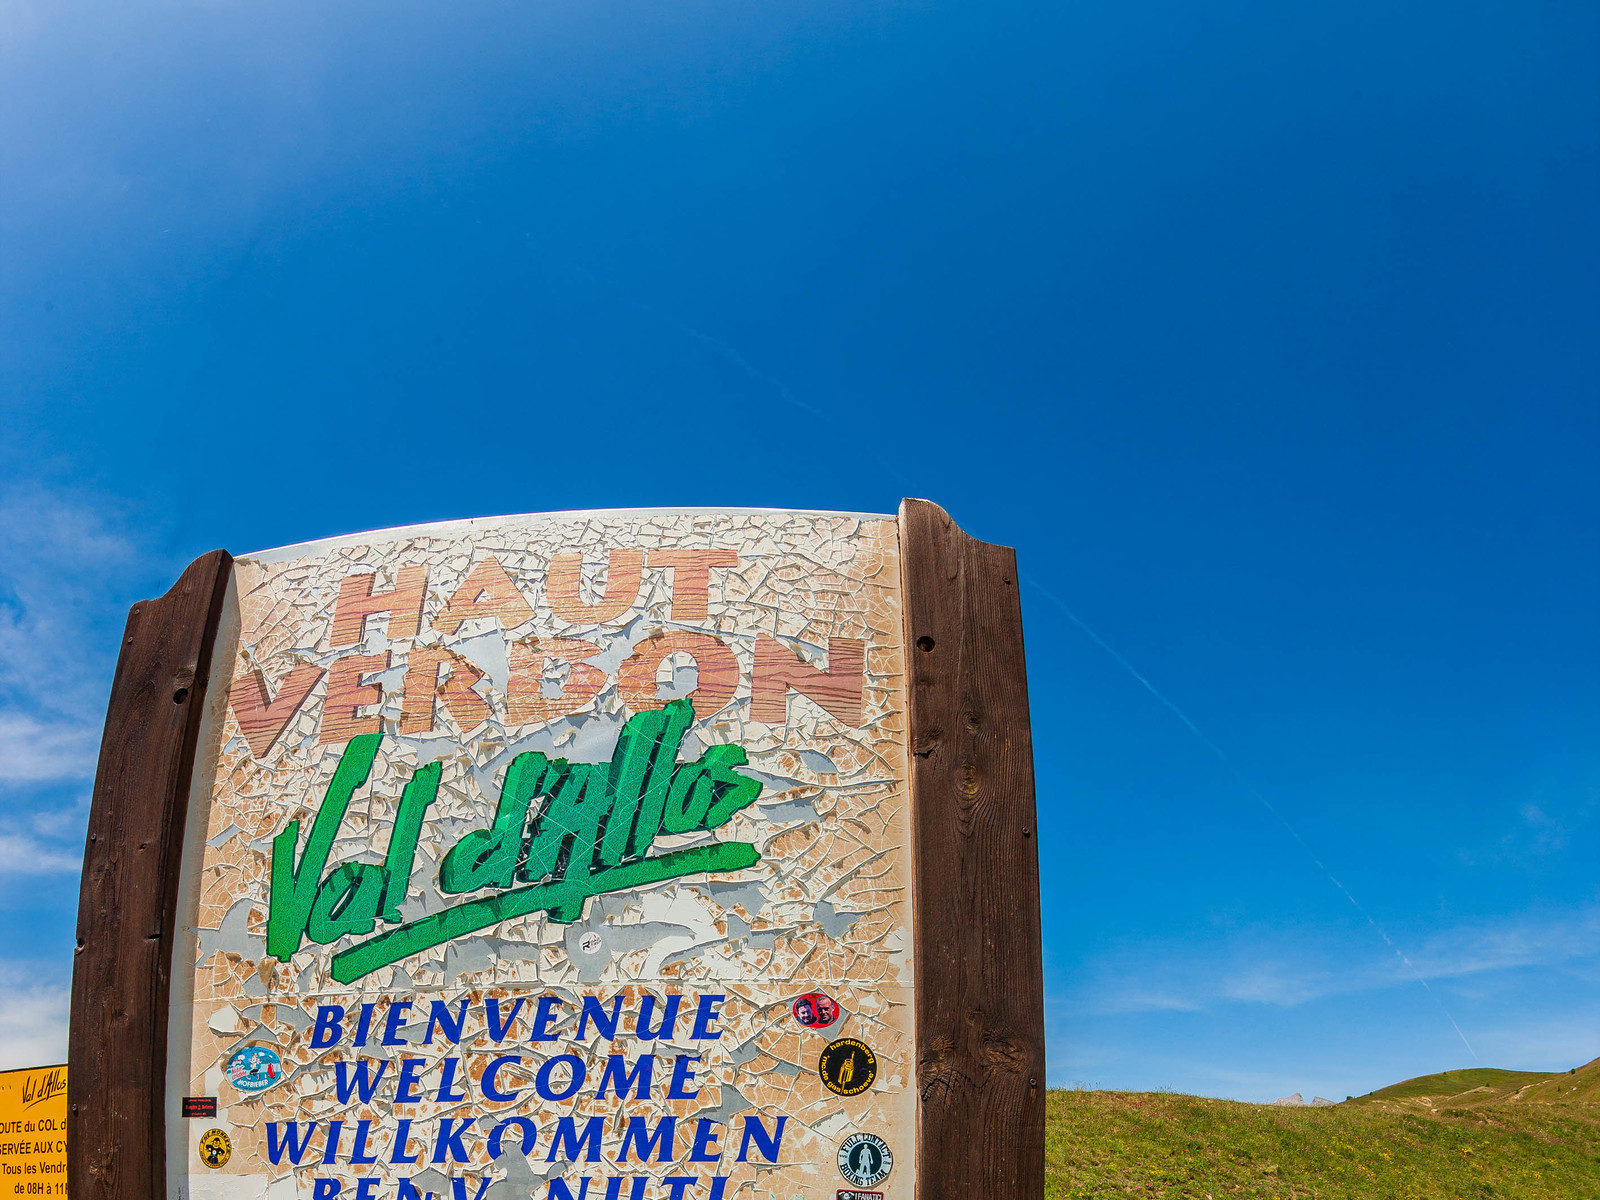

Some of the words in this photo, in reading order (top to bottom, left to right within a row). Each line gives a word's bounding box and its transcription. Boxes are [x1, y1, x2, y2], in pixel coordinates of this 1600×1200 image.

[331, 548, 739, 648] HAUT
[267, 731, 443, 963] Val
[308, 993, 726, 1049] BIENVENUE
[829, 1038, 875, 1065] hardenberg
[22, 1076, 38, 1104] Val
[333, 1053, 703, 1105] WELCOME
[0, 1121, 22, 1134] OUTE
[24, 1120, 36, 1133] du
[38, 1118, 58, 1132] COL
[0, 1139, 32, 1155] ERVÉE
[33, 1141, 53, 1154] AUX
[55, 1140, 67, 1153] CY
[265, 1114, 787, 1167] WILLKOMMEN
[841, 1133, 861, 1153] FULL
[2, 1161, 22, 1175] Tous
[24, 1161, 37, 1174] les
[38, 1160, 67, 1174] Vendr
[840, 1162, 864, 1186] BOXING
[866, 1168, 888, 1186] TEAM
[14, 1182, 25, 1194] de
[27, 1182, 44, 1195] 08H
[46, 1182, 52, 1195] à
